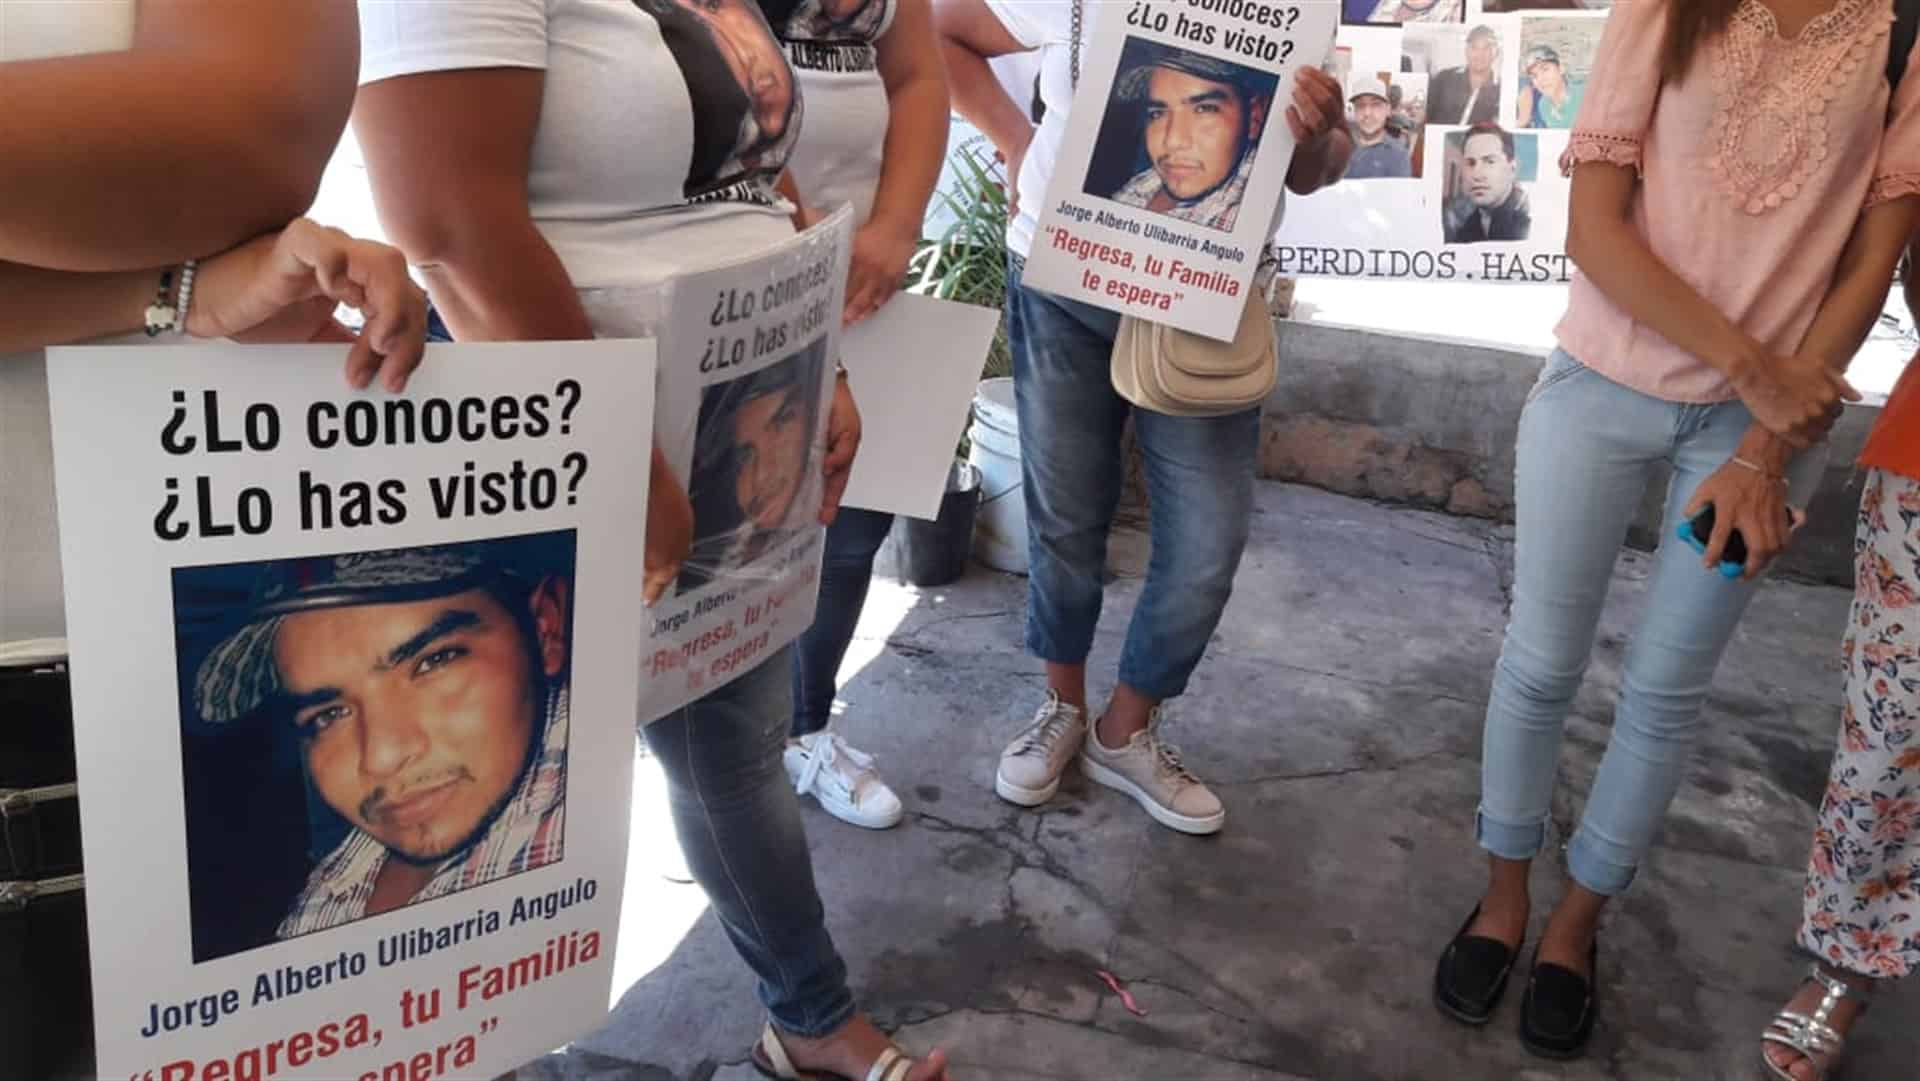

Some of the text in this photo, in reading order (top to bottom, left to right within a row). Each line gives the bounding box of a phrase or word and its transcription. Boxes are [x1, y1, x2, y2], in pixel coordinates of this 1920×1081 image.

[1127, 1, 1294, 65] ¿Lo has visto?
[1046, 225, 1240, 297] “Regresa, tu Familia
[1056, 200, 1245, 263] Jorge Alberto Ulibarria Angulo
[710, 289, 756, 327] ¿Lo
[1082, 268, 1184, 311] te espera”
[699, 336, 746, 373] ¿Lo
[752, 322, 788, 359] has
[160, 379, 582, 456] ¿Lo conoces?
[153, 451, 588, 541] ¿Lo has visto?
[140, 876, 597, 1038] Jorge Alberto Ulibarria Angulo
[400, 988, 440, 1029] tu
[457, 930, 601, 1012] Familia
